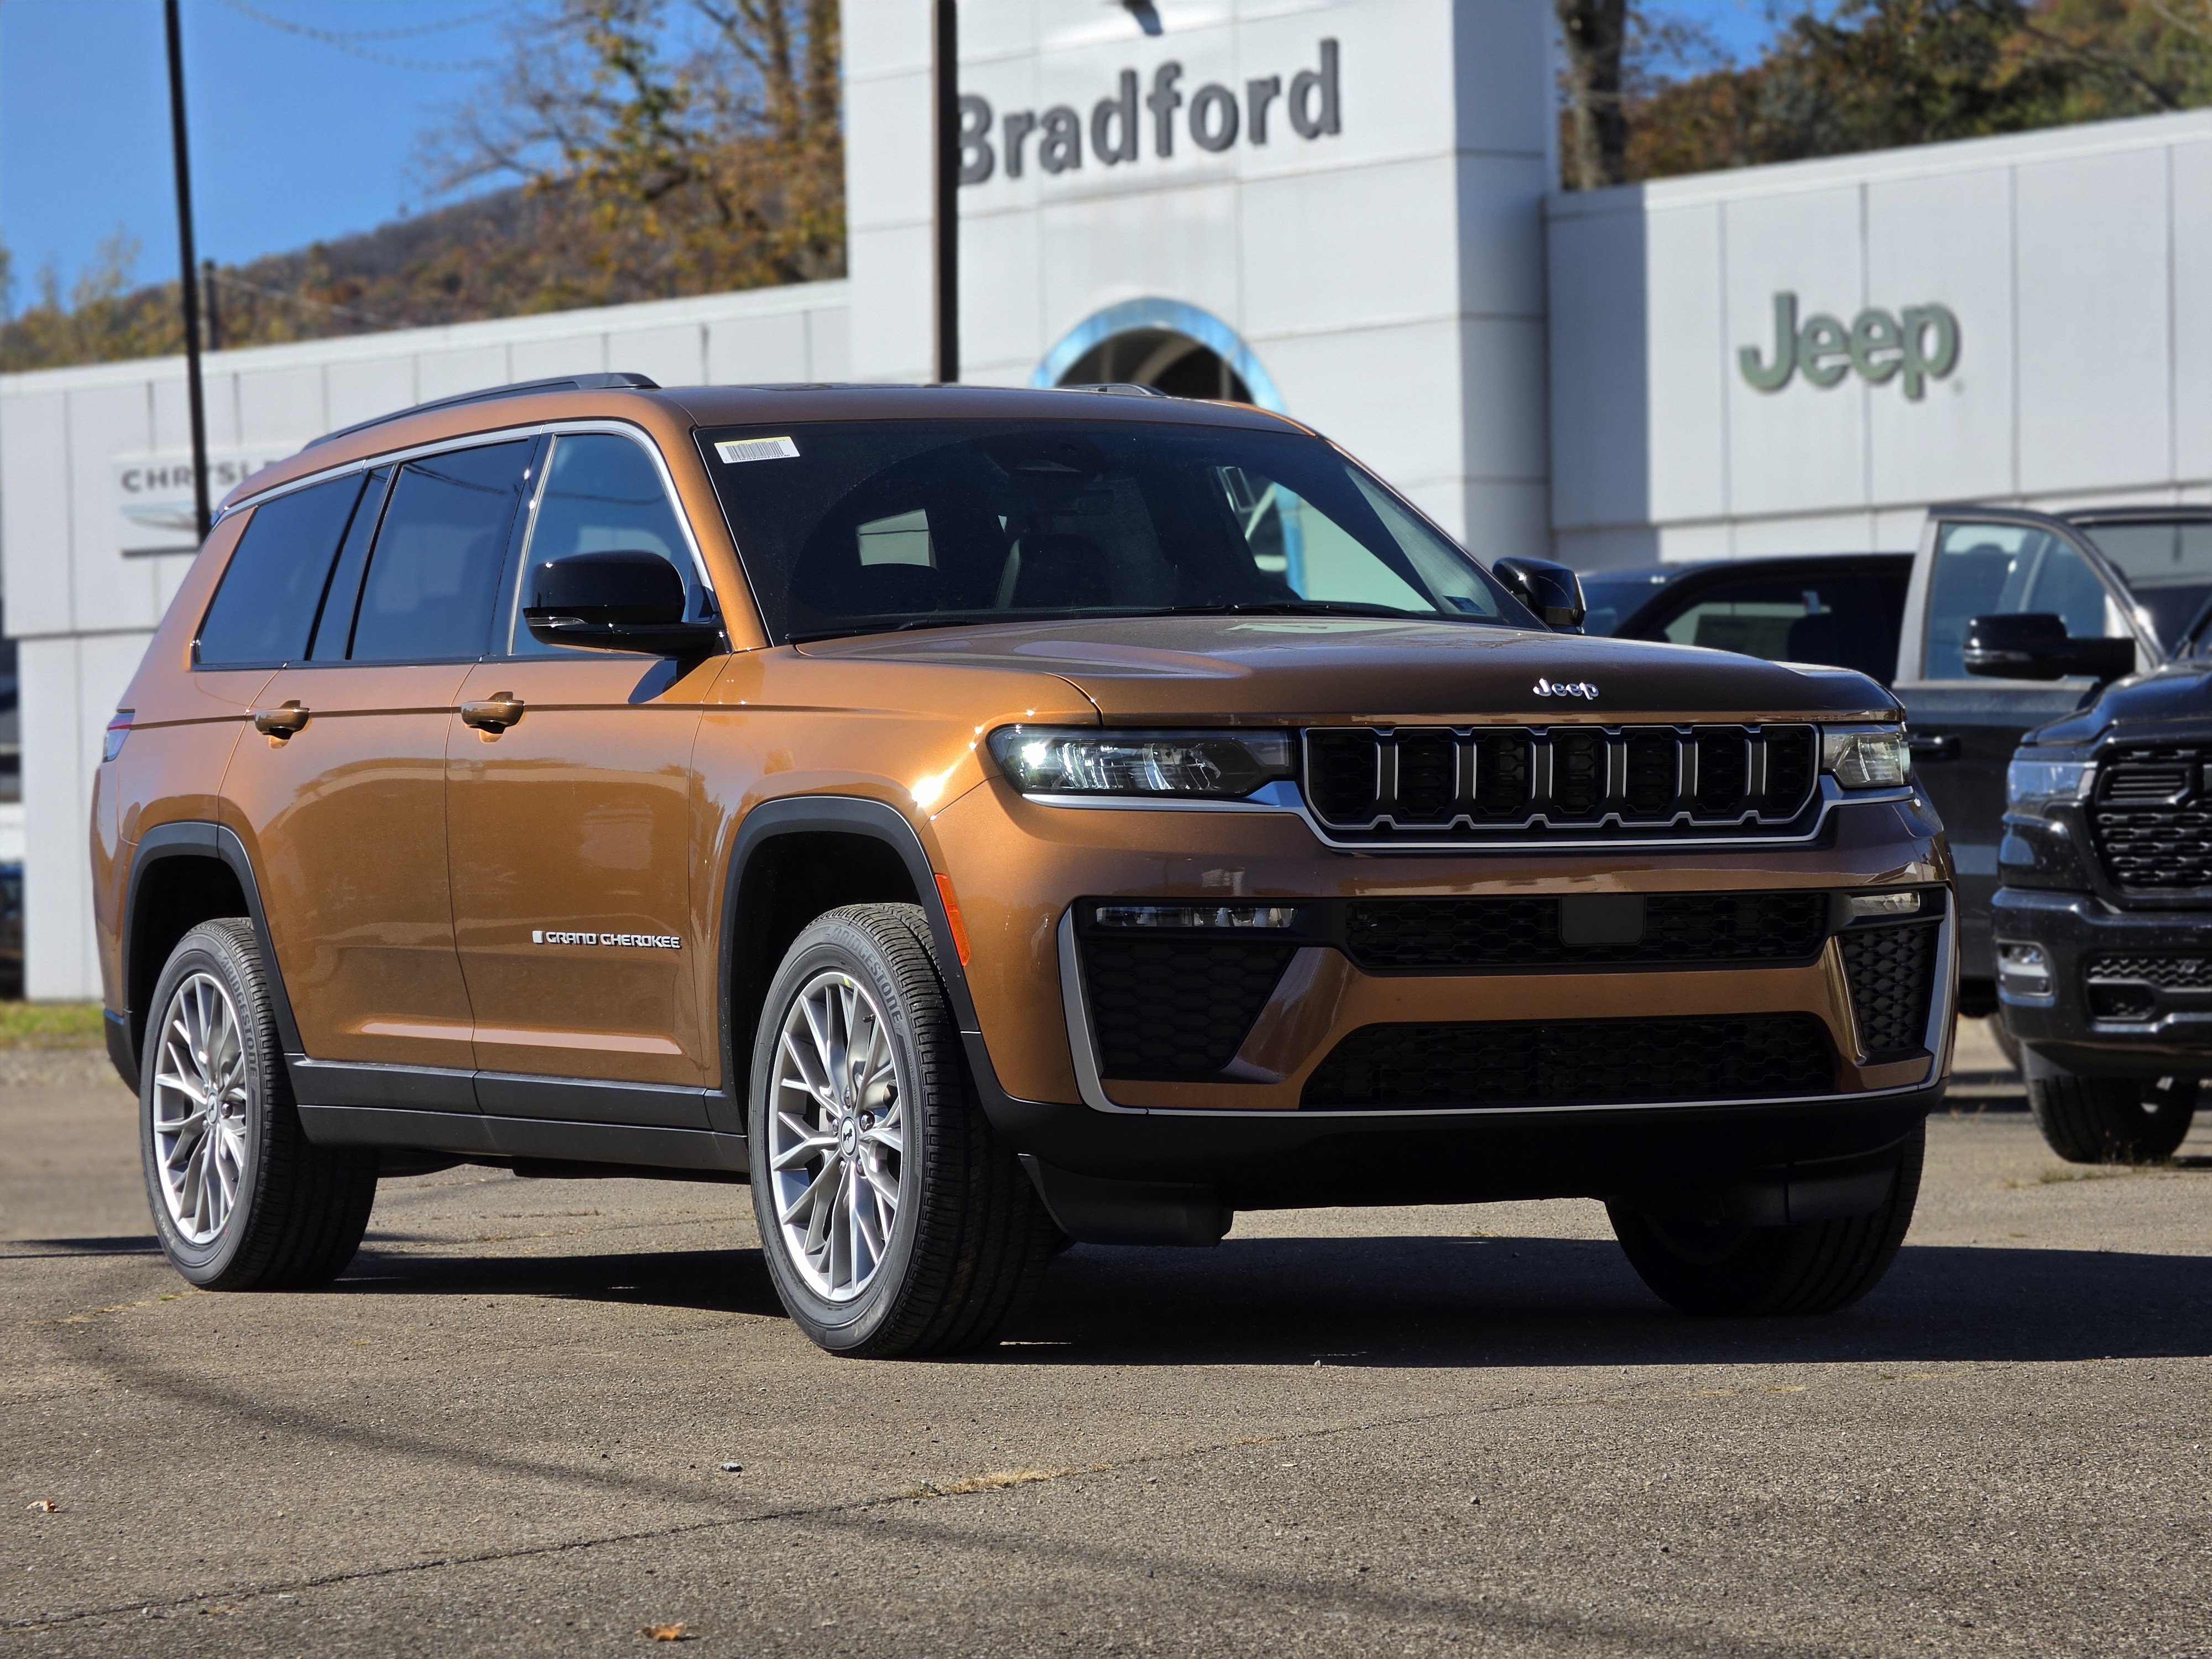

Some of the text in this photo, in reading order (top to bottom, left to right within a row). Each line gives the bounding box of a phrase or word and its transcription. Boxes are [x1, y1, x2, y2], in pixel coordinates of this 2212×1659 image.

[958, 37, 1340, 185] Bradford
[1738, 290, 1961, 401] Jeep
[1532, 677, 1599, 700] Jeep
[546, 931, 681, 949] GRAND CHEROKEE
[829, 926, 904, 1024] BRIDGESTONE
[220, 956, 258, 1079] BRIDGESTONE
